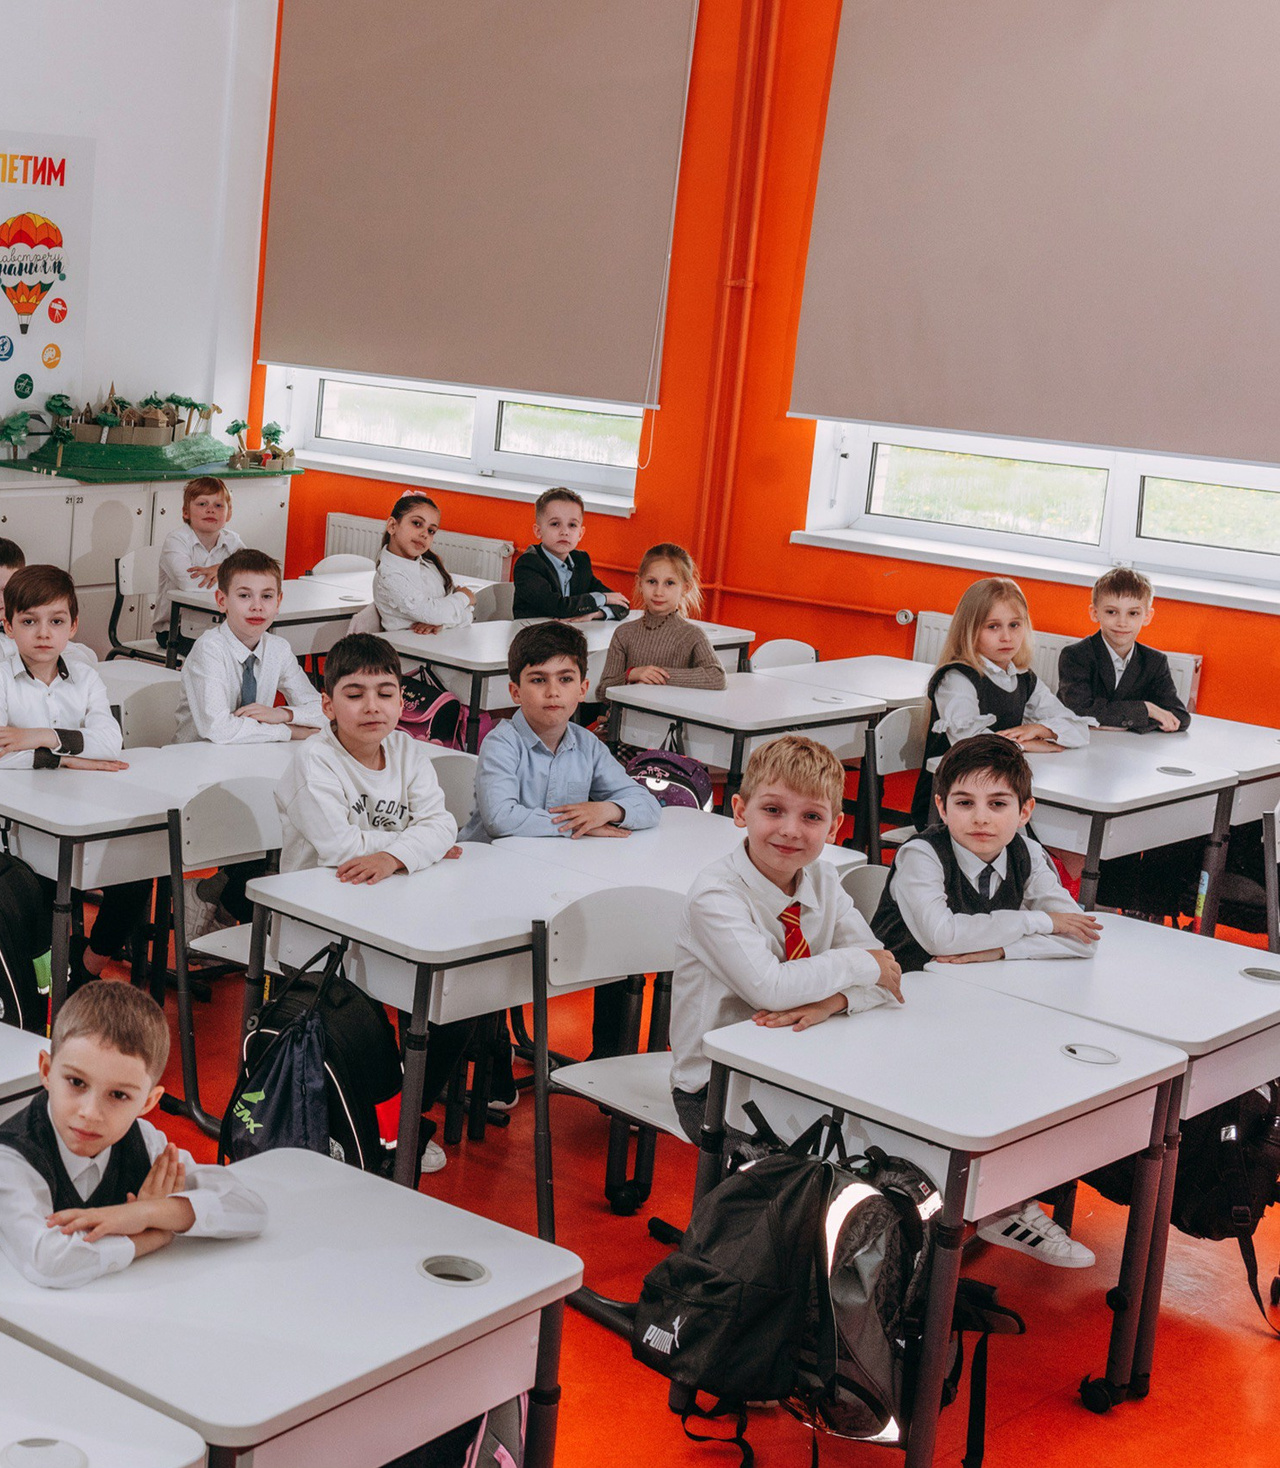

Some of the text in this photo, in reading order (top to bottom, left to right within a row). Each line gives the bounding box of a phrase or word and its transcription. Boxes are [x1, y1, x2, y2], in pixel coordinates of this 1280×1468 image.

[65, 496, 73, 504] 21
[76, 496, 84, 504] 23
[642, 1324, 674, 1355] PUMA
